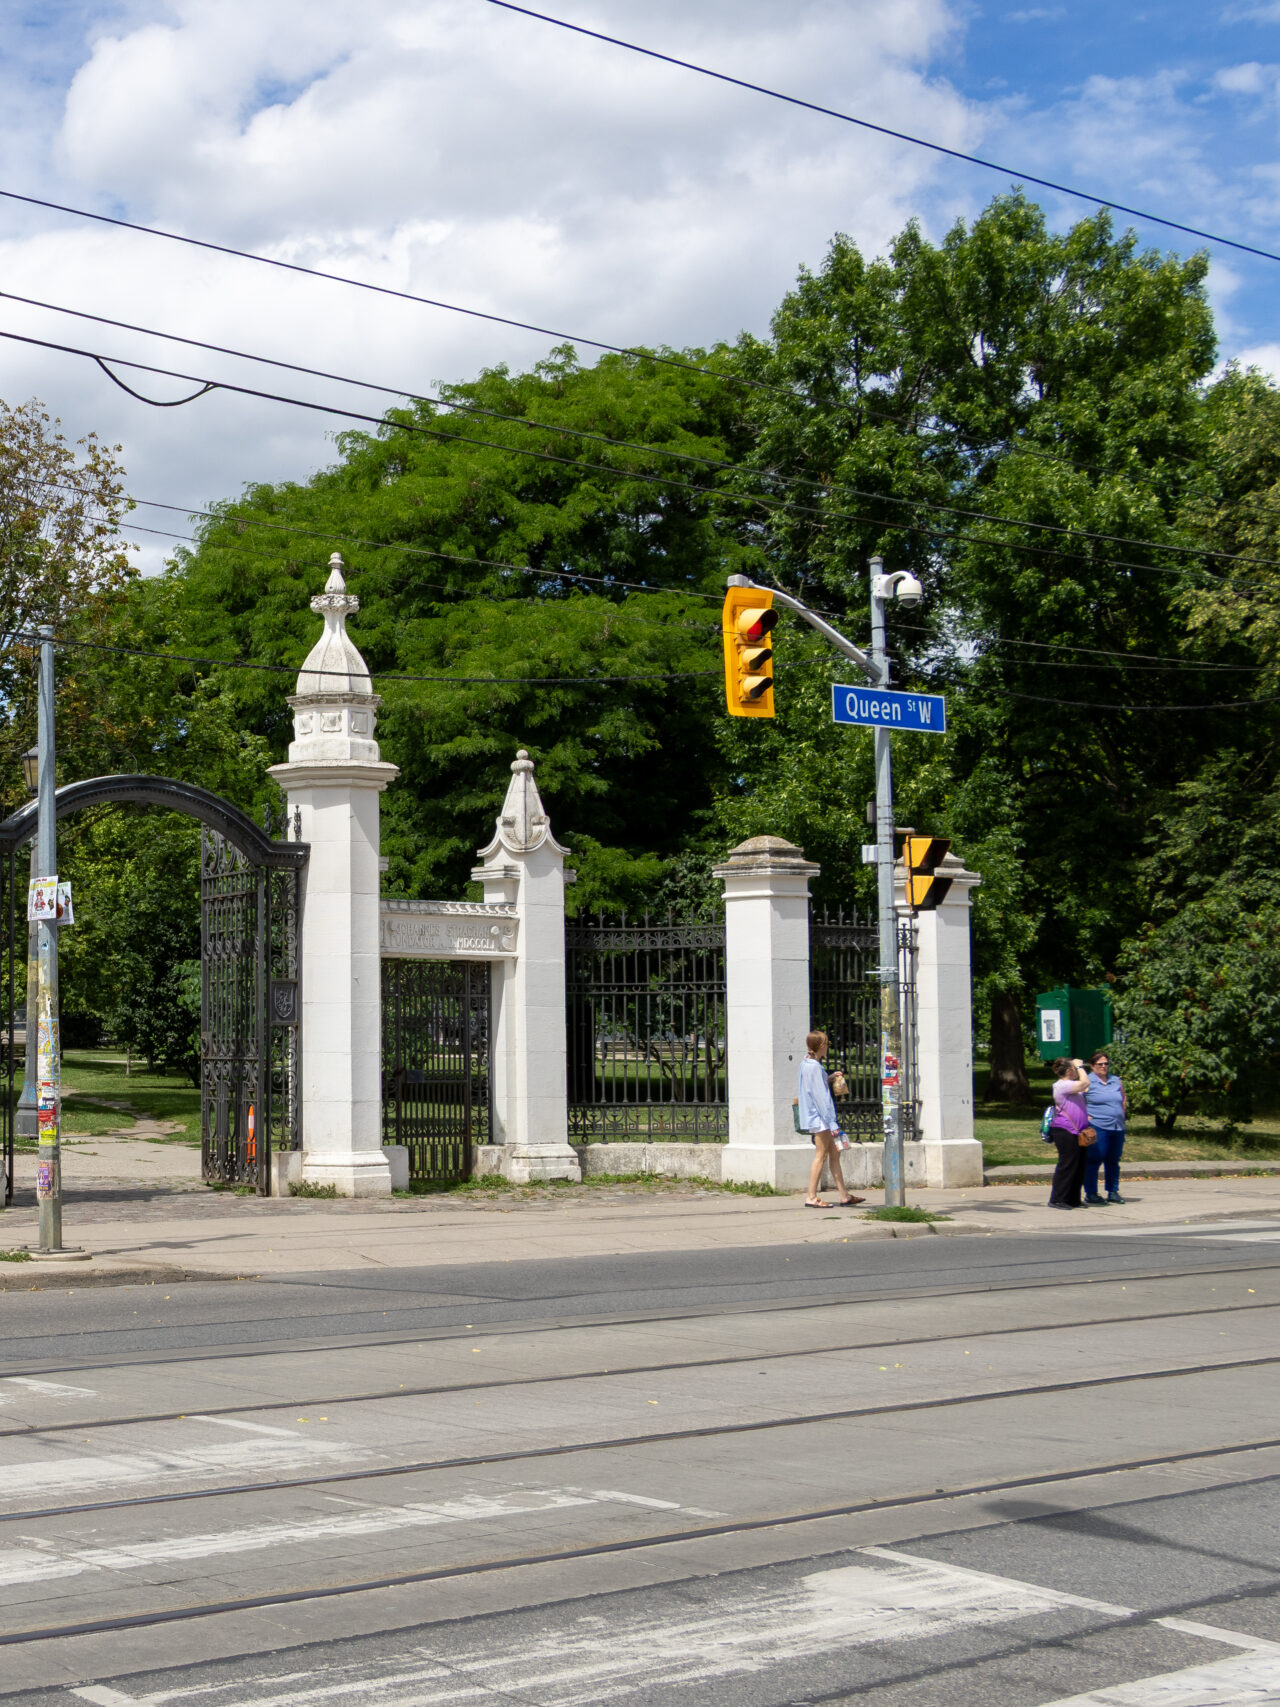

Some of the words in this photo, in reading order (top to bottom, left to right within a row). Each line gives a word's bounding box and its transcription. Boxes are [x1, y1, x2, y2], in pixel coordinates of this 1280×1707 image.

[846, 692, 902, 721] Queen
[907, 699, 917, 712] St
[918, 700, 932, 724] W
[397, 922, 441, 936] JOHANNES
[456, 937, 495, 950] MDCCCLI
